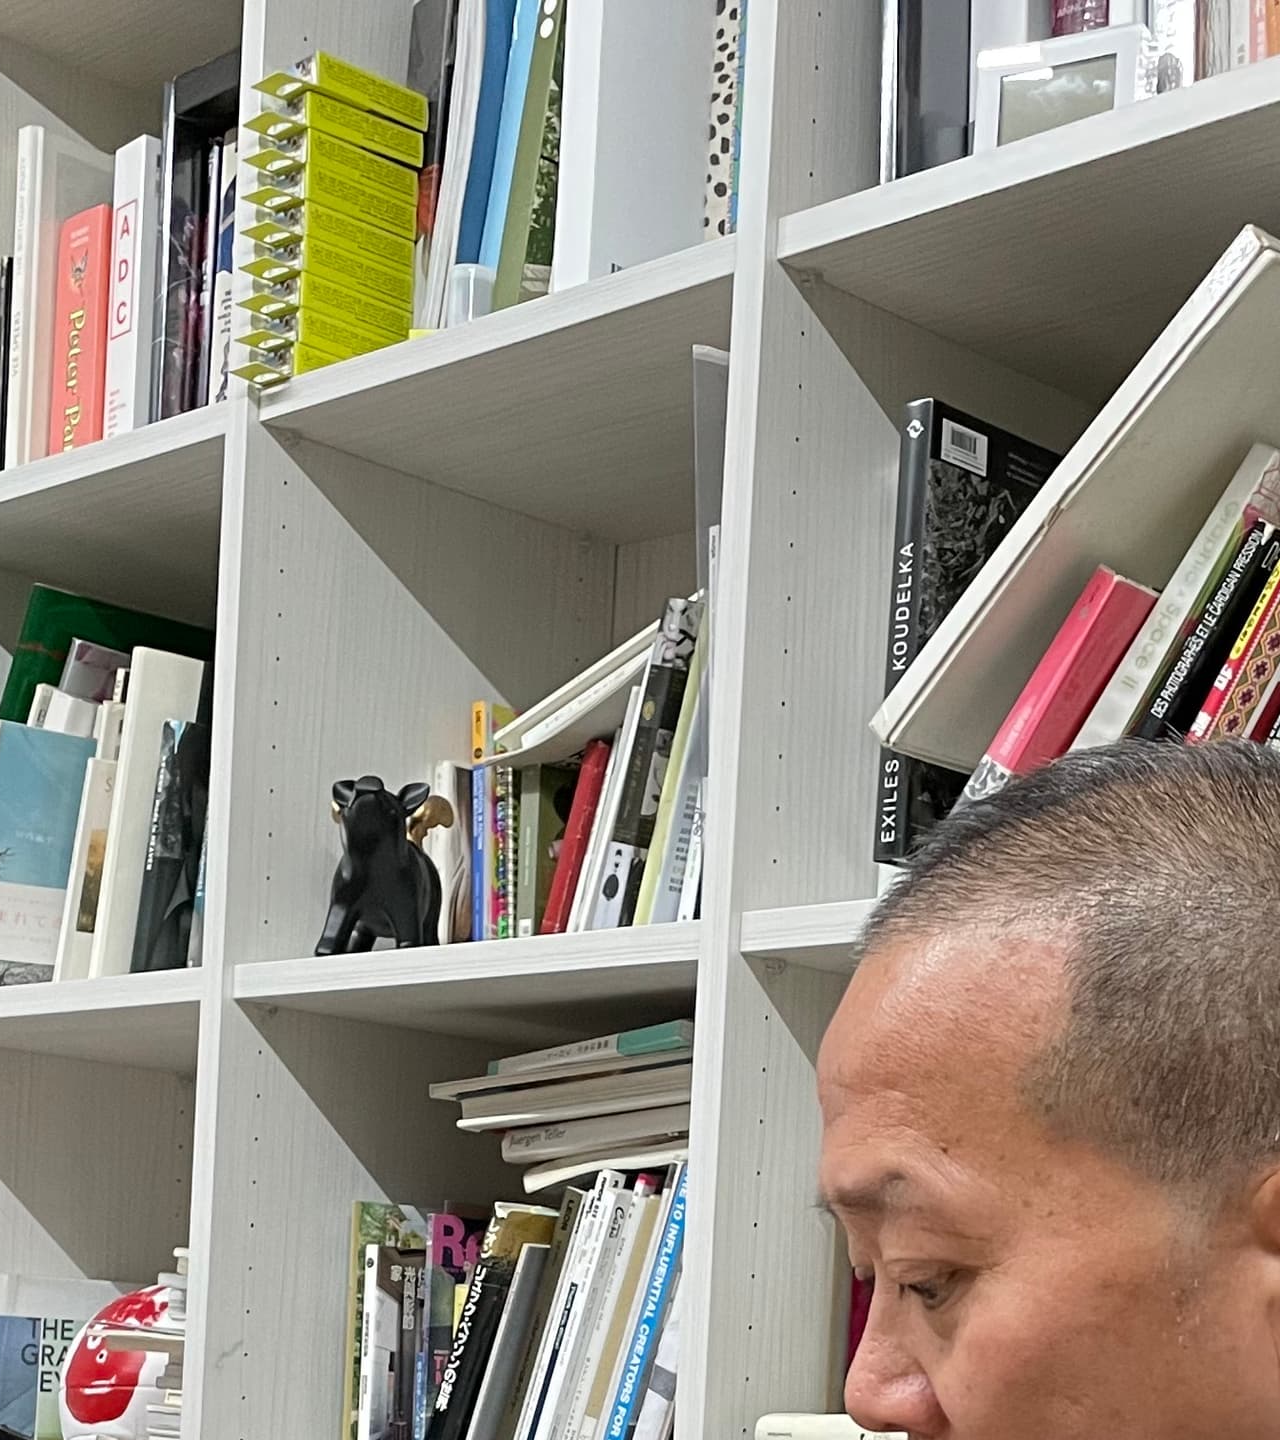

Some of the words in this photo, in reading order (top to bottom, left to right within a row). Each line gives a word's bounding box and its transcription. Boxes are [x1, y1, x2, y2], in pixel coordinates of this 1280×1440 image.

[64, 308, 87, 391] Peter
[892, 542, 915, 672] KOUDELKA
[1149, 697, 1169, 718] DES
[1195, 623, 1211, 639] ET
[1232, 528, 1264, 572] PRESSION
[880, 758, 900, 845] EXILES
[671, 1201, 687, 1221] 10
[641, 1222, 682, 1321] INFLUENTIAL
[26, 1318, 74, 1341] THE
[617, 1322, 652, 1405] CREATORS
[608, 1405, 628, 1437] FOR
